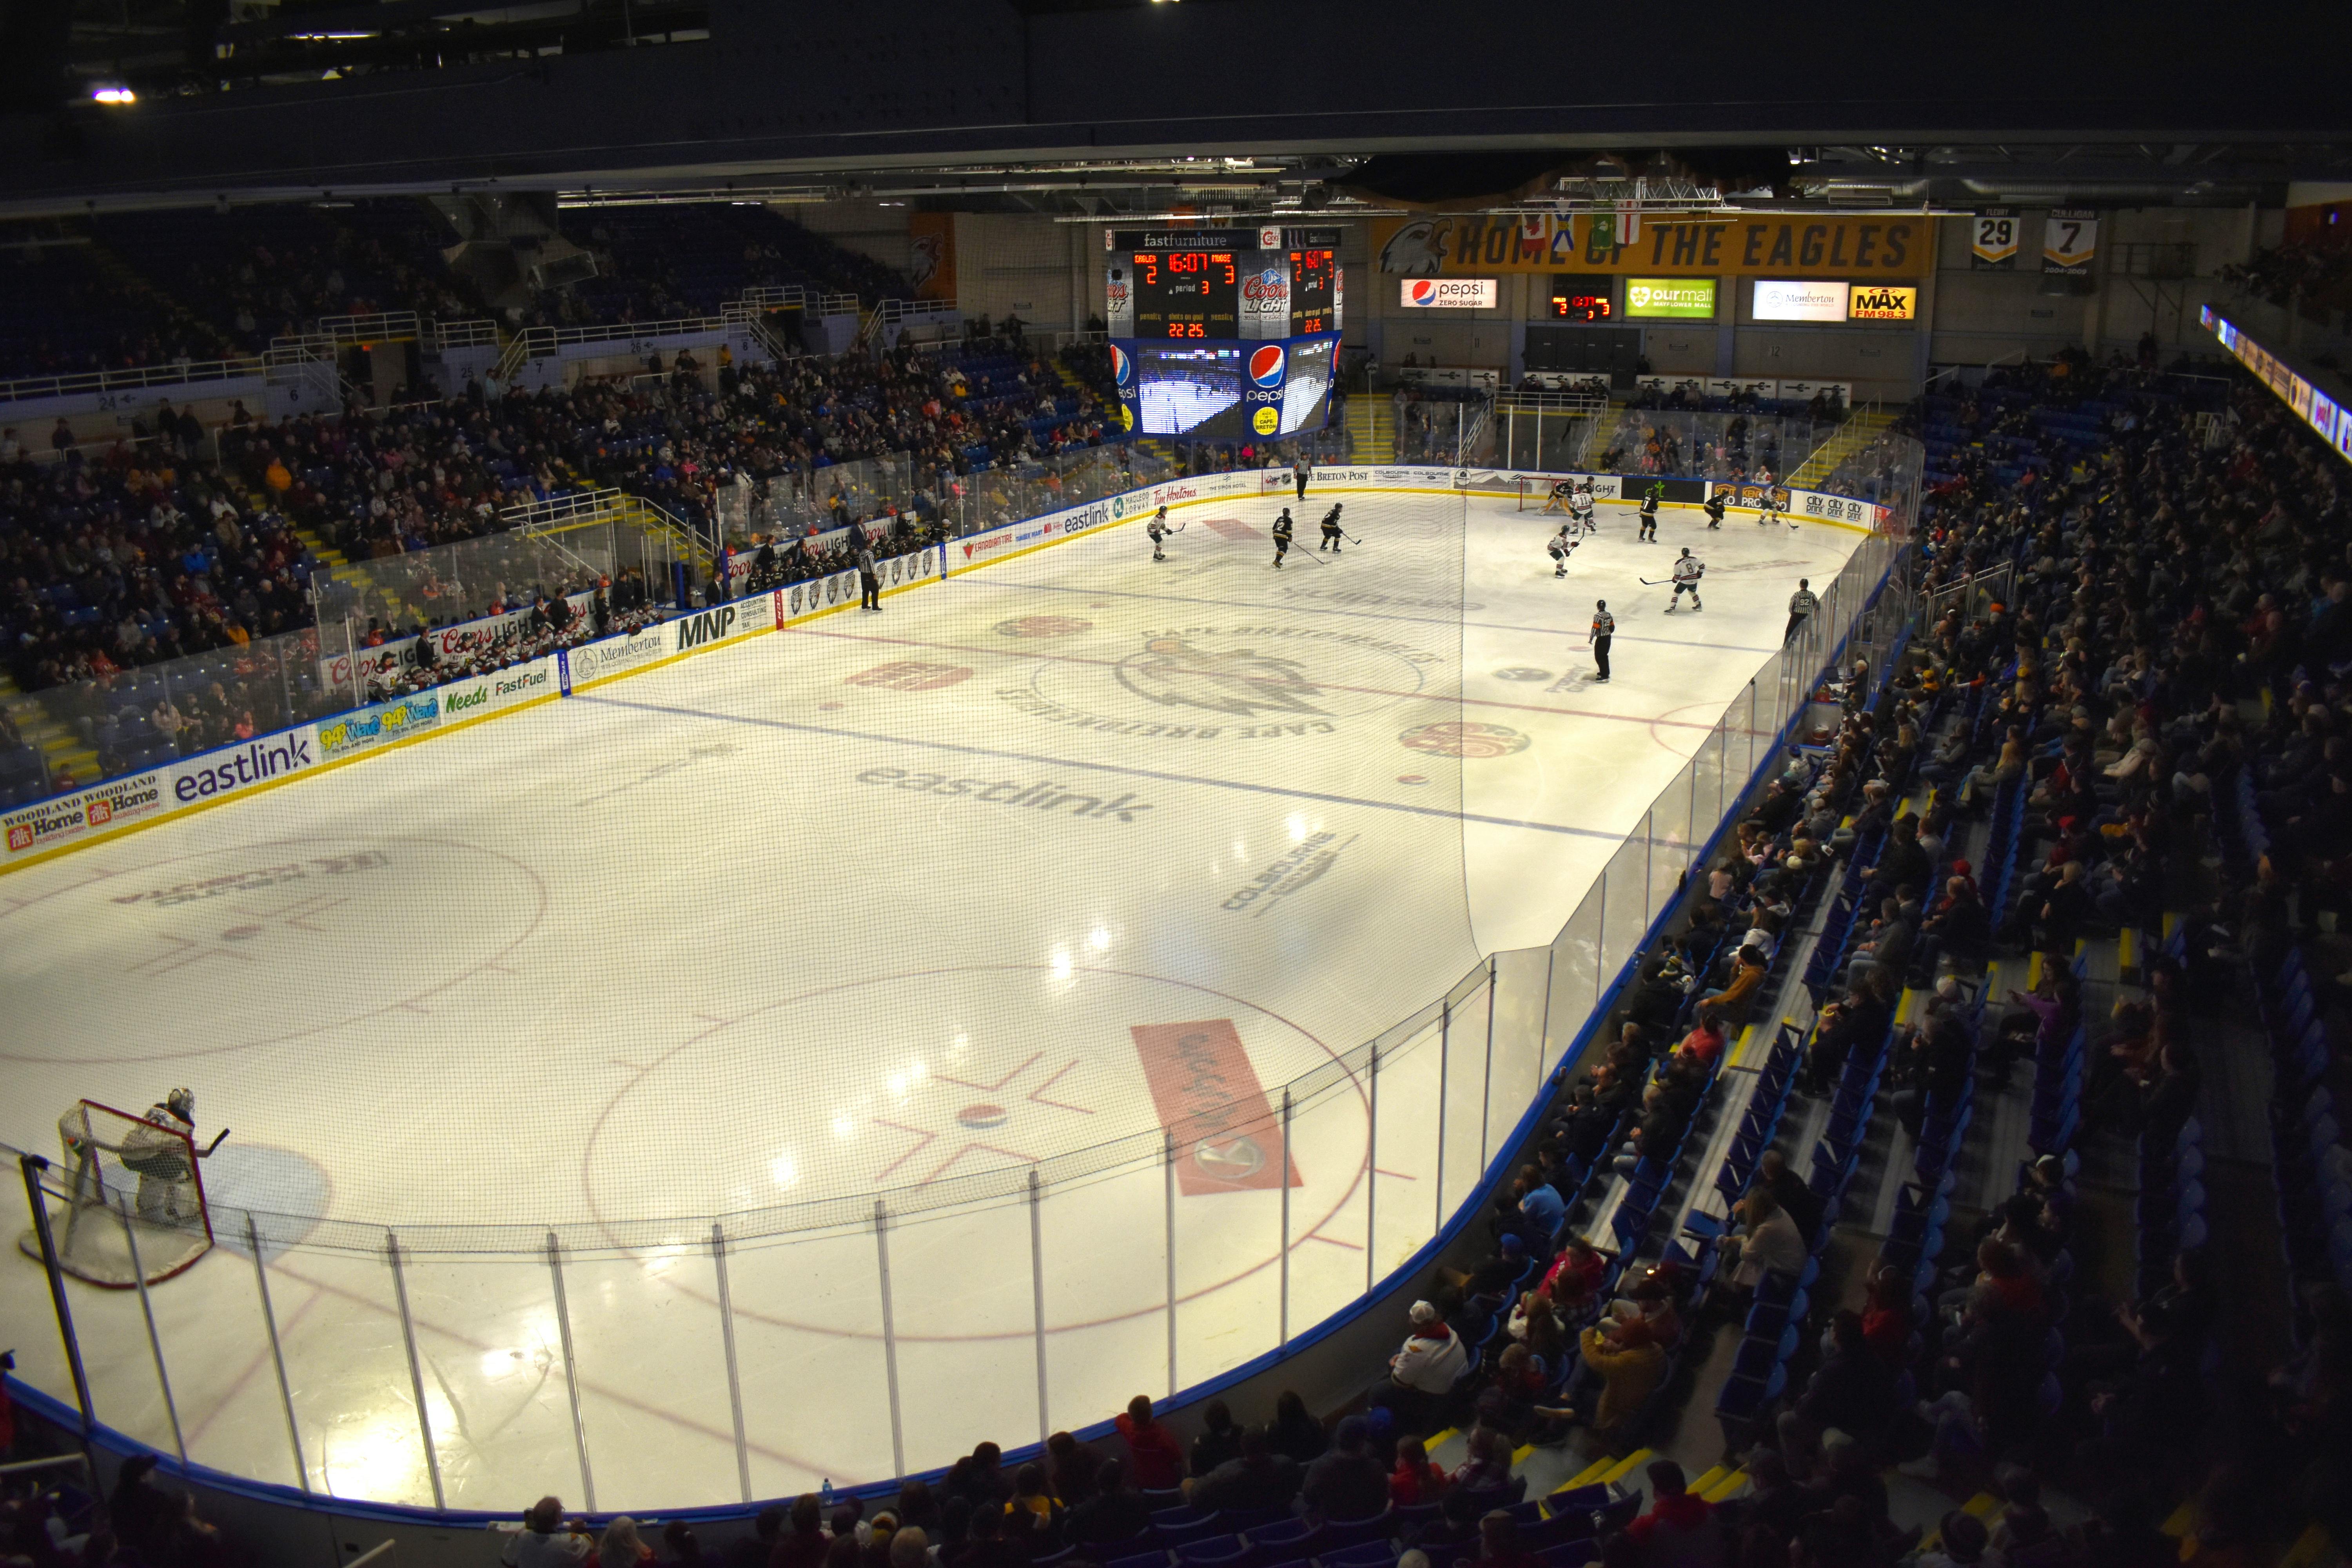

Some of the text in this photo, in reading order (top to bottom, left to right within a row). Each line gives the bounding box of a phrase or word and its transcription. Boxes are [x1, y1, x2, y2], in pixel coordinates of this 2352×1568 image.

[2052, 209, 2094, 218] CULLIGAN
[1144, 232, 1227, 247] fastfurniture
[1980, 220, 2012, 245] 29
[2058, 222, 2081, 253] 7
[1651, 225, 1726, 266] THE
[1743, 224, 1912, 268] EAGLES
[1135, 255, 1156, 263] EAGLES
[1147, 265, 1234, 284] 2 3
[1176, 284, 1195, 293] period
[1201, 281, 1209, 294] 3
[1243, 274, 1288, 300] Coors
[1439, 281, 1483, 298] pepsi
[1786, 291, 1834, 303] Membertou
[1857, 289, 1907, 310] MAX
[1245, 299, 1287, 313] LIGHT
[1560, 303, 1610, 319] 2 3 3
[1169, 323, 1204, 338] 22 25
[630, 342, 641, 353] 26
[1770, 346, 1780, 357] 12
[536, 363, 543, 373] 7
[1246, 386, 1283, 403] pepsi
[98, 396, 117, 411] 24
[1317, 472, 1347, 481] BRETON
[1349, 471, 1368, 480] POST
[1154, 486, 1197, 506] Tim Hortons
[1592, 485, 1616, 494] IGHT
[1775, 491, 1789, 501] ENT
[1126, 492, 1149, 503] MACLEOD
[1580, 496, 1587, 506] 11
[1742, 497, 1762, 508] PRO
[1807, 495, 1824, 506] city
[1828, 498, 1843, 510] city
[1126, 501, 1149, 514] LORWAY
[1806, 505, 1823, 513] print
[1828, 508, 1843, 517] print
[1848, 502, 1862, 513] city
[1065, 503, 1109, 533] eastlink
[1847, 511, 1861, 521] print
[863, 524, 887, 542] oors
[1016, 532, 1031, 542] TIMBER
[826, 535, 849, 553] LIGH
[975, 533, 1012, 552] CANADIAN TIRE
[727, 558, 752, 578] Coor
[1686, 563, 1693, 573] 8
[740, 597, 766, 609] ACCOUNTING
[741, 607, 767, 619] CONSULTING
[495, 615, 532, 639] LIGH
[678, 606, 736, 650] MNP
[600, 635, 661, 663] Membertou
[446, 685, 488, 714] Needs
[407, 698, 438, 724] Wave
[347, 715, 381, 742] Wave
[175, 733, 311, 802] eastlink
[83, 775, 156, 803] WOODLAND
[855, 766, 1153, 822] eastlink
[111, 788, 158, 812] Home
[4, 797, 81, 827] WOODLAND
[33, 811, 84, 836] Home
